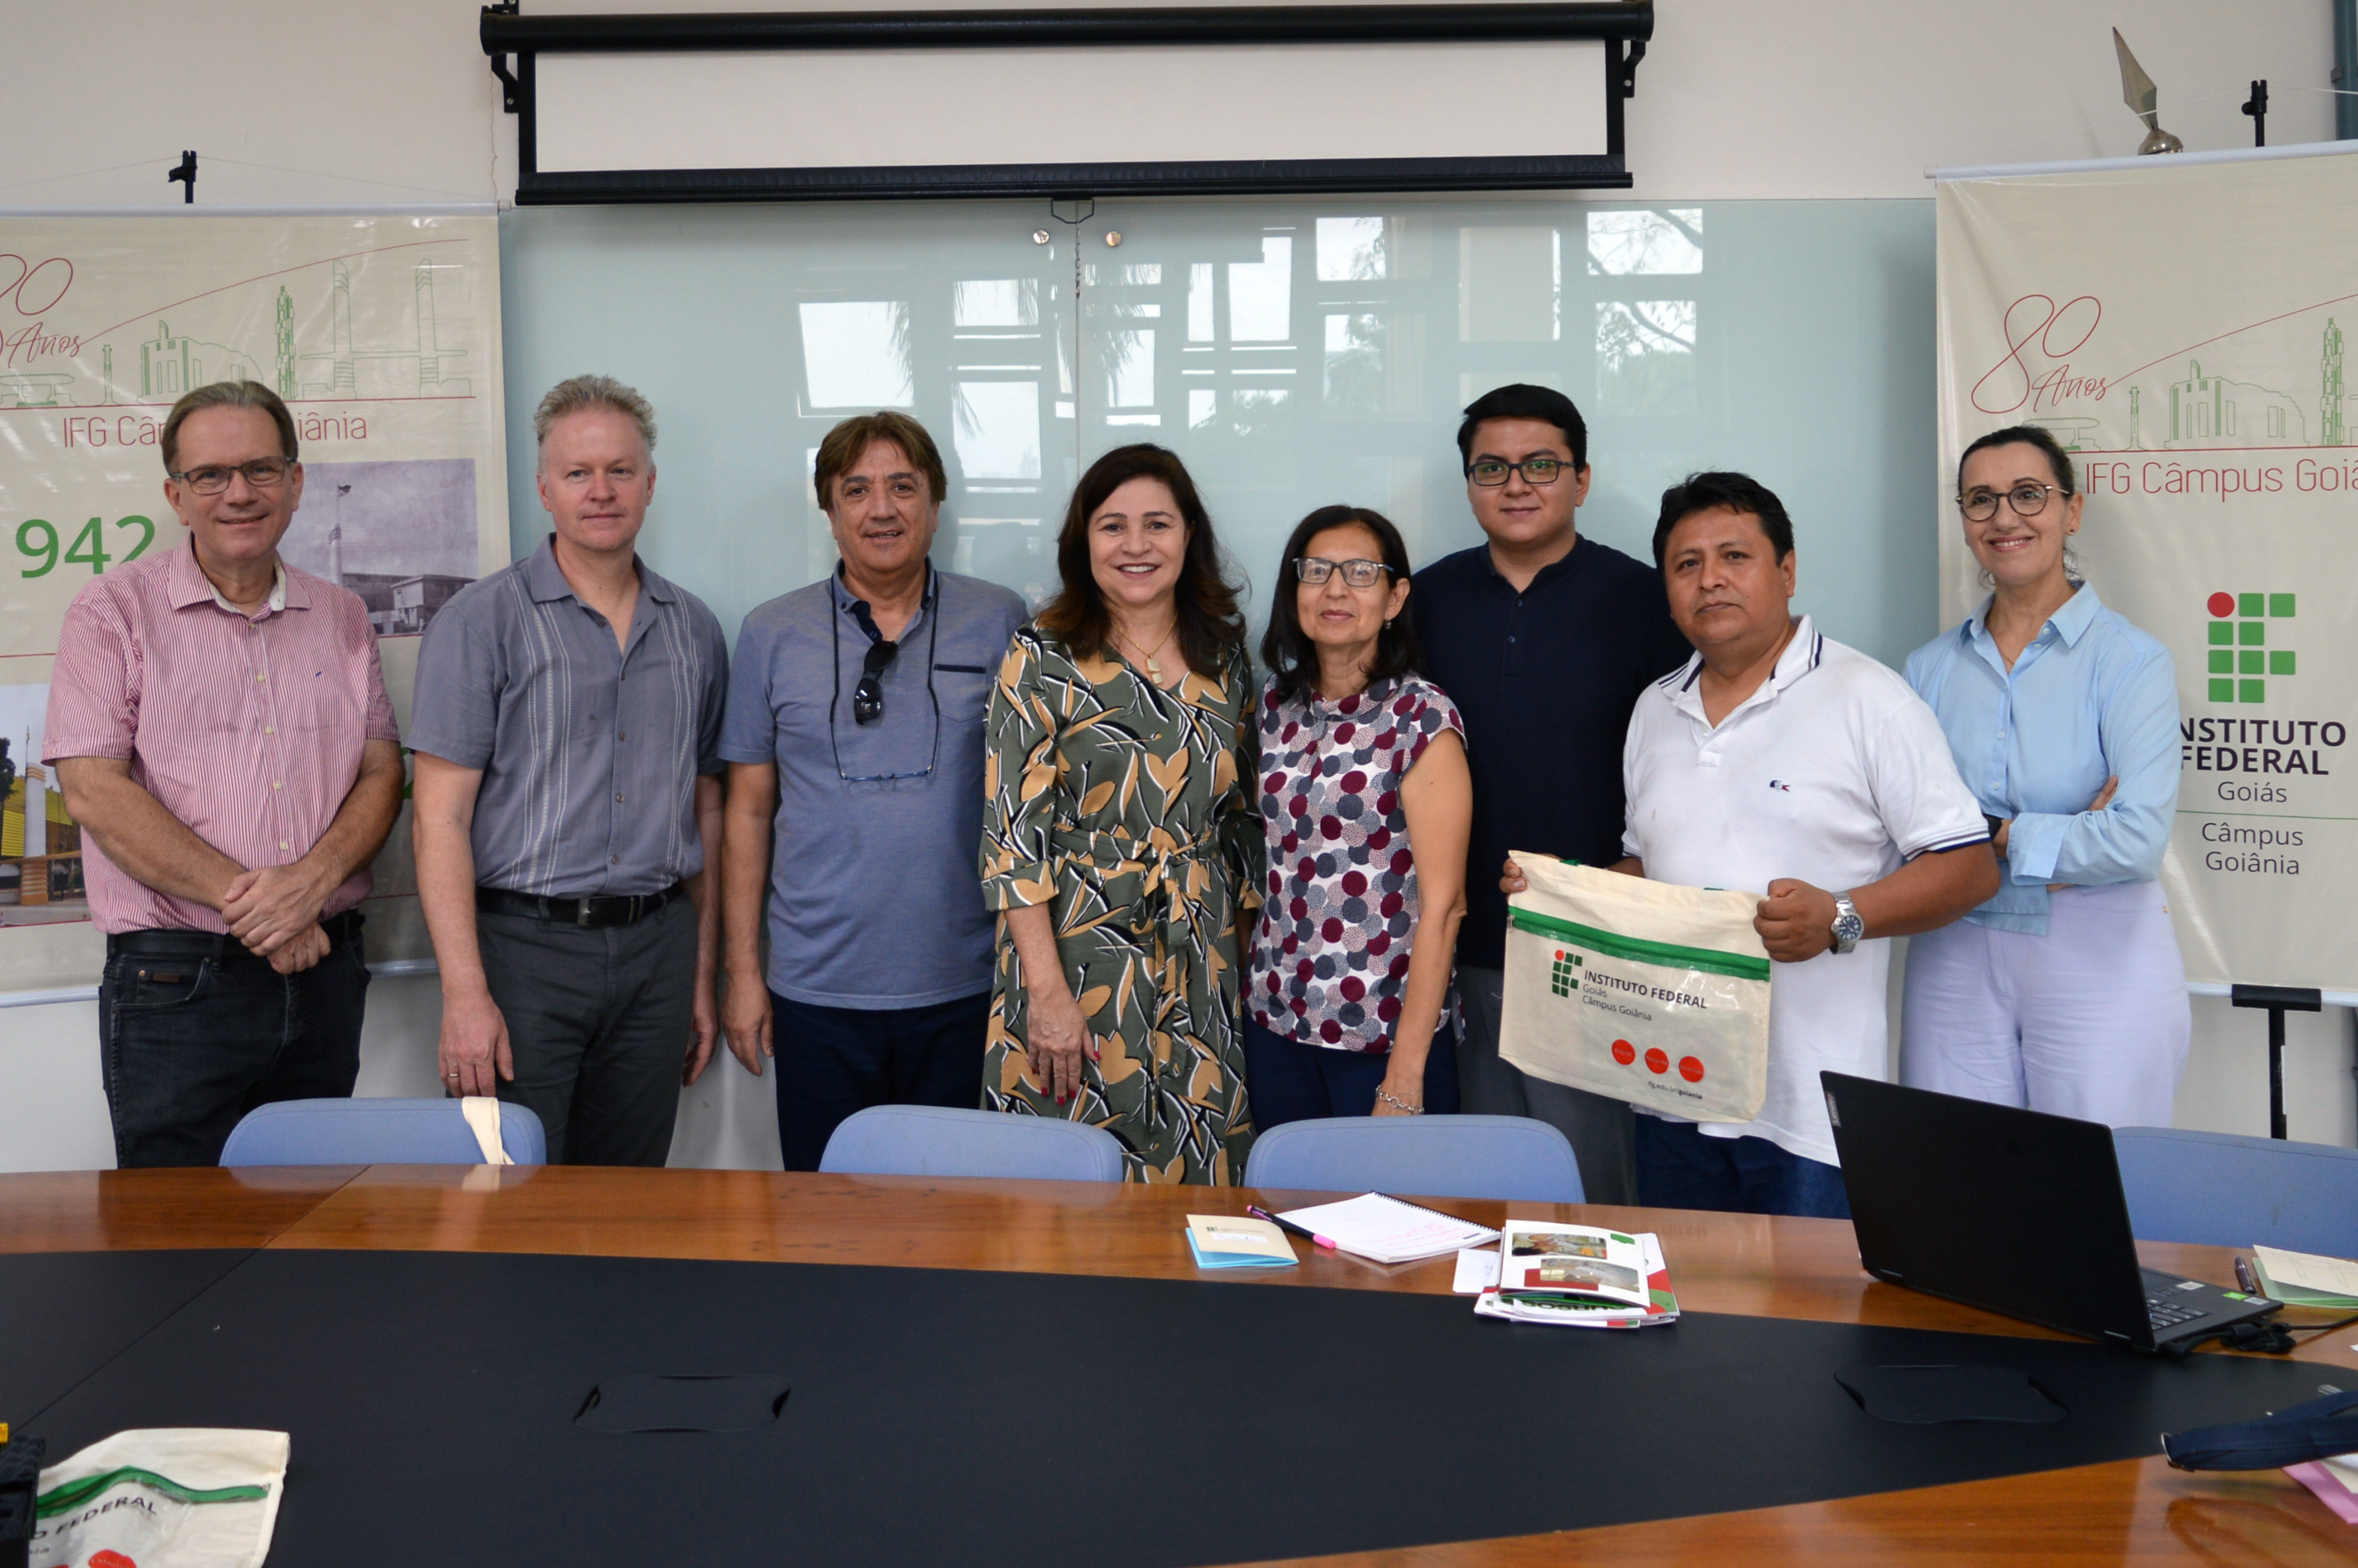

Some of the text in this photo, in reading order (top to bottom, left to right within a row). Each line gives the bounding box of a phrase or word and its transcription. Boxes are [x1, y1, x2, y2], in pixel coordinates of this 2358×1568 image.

[5, 322, 80, 368] Anos
[1971, 294, 2102, 414] 80
[2031, 364, 2106, 413] Anos
[64, 416, 106, 447] IFG
[297, 411, 367, 441] iânia
[2086, 462, 2130, 495] IFG
[2142, 462, 2283, 502] Câmpus
[2180, 717, 2346, 747] NSTITUTO
[2181, 745, 2329, 775] FEDERAL
[2218, 781, 2287, 803] Goiás
[2202, 822, 2303, 850] Câmpus
[2205, 851, 2299, 875] Goiânia
[1583, 984, 1608, 998] Goiás
[1584, 970, 1707, 1009] INSTITUTO FEDERAL
[1583, 996, 1652, 1021] Câmpus Goiânia
[56, 1497, 157, 1535] FEDERAL
